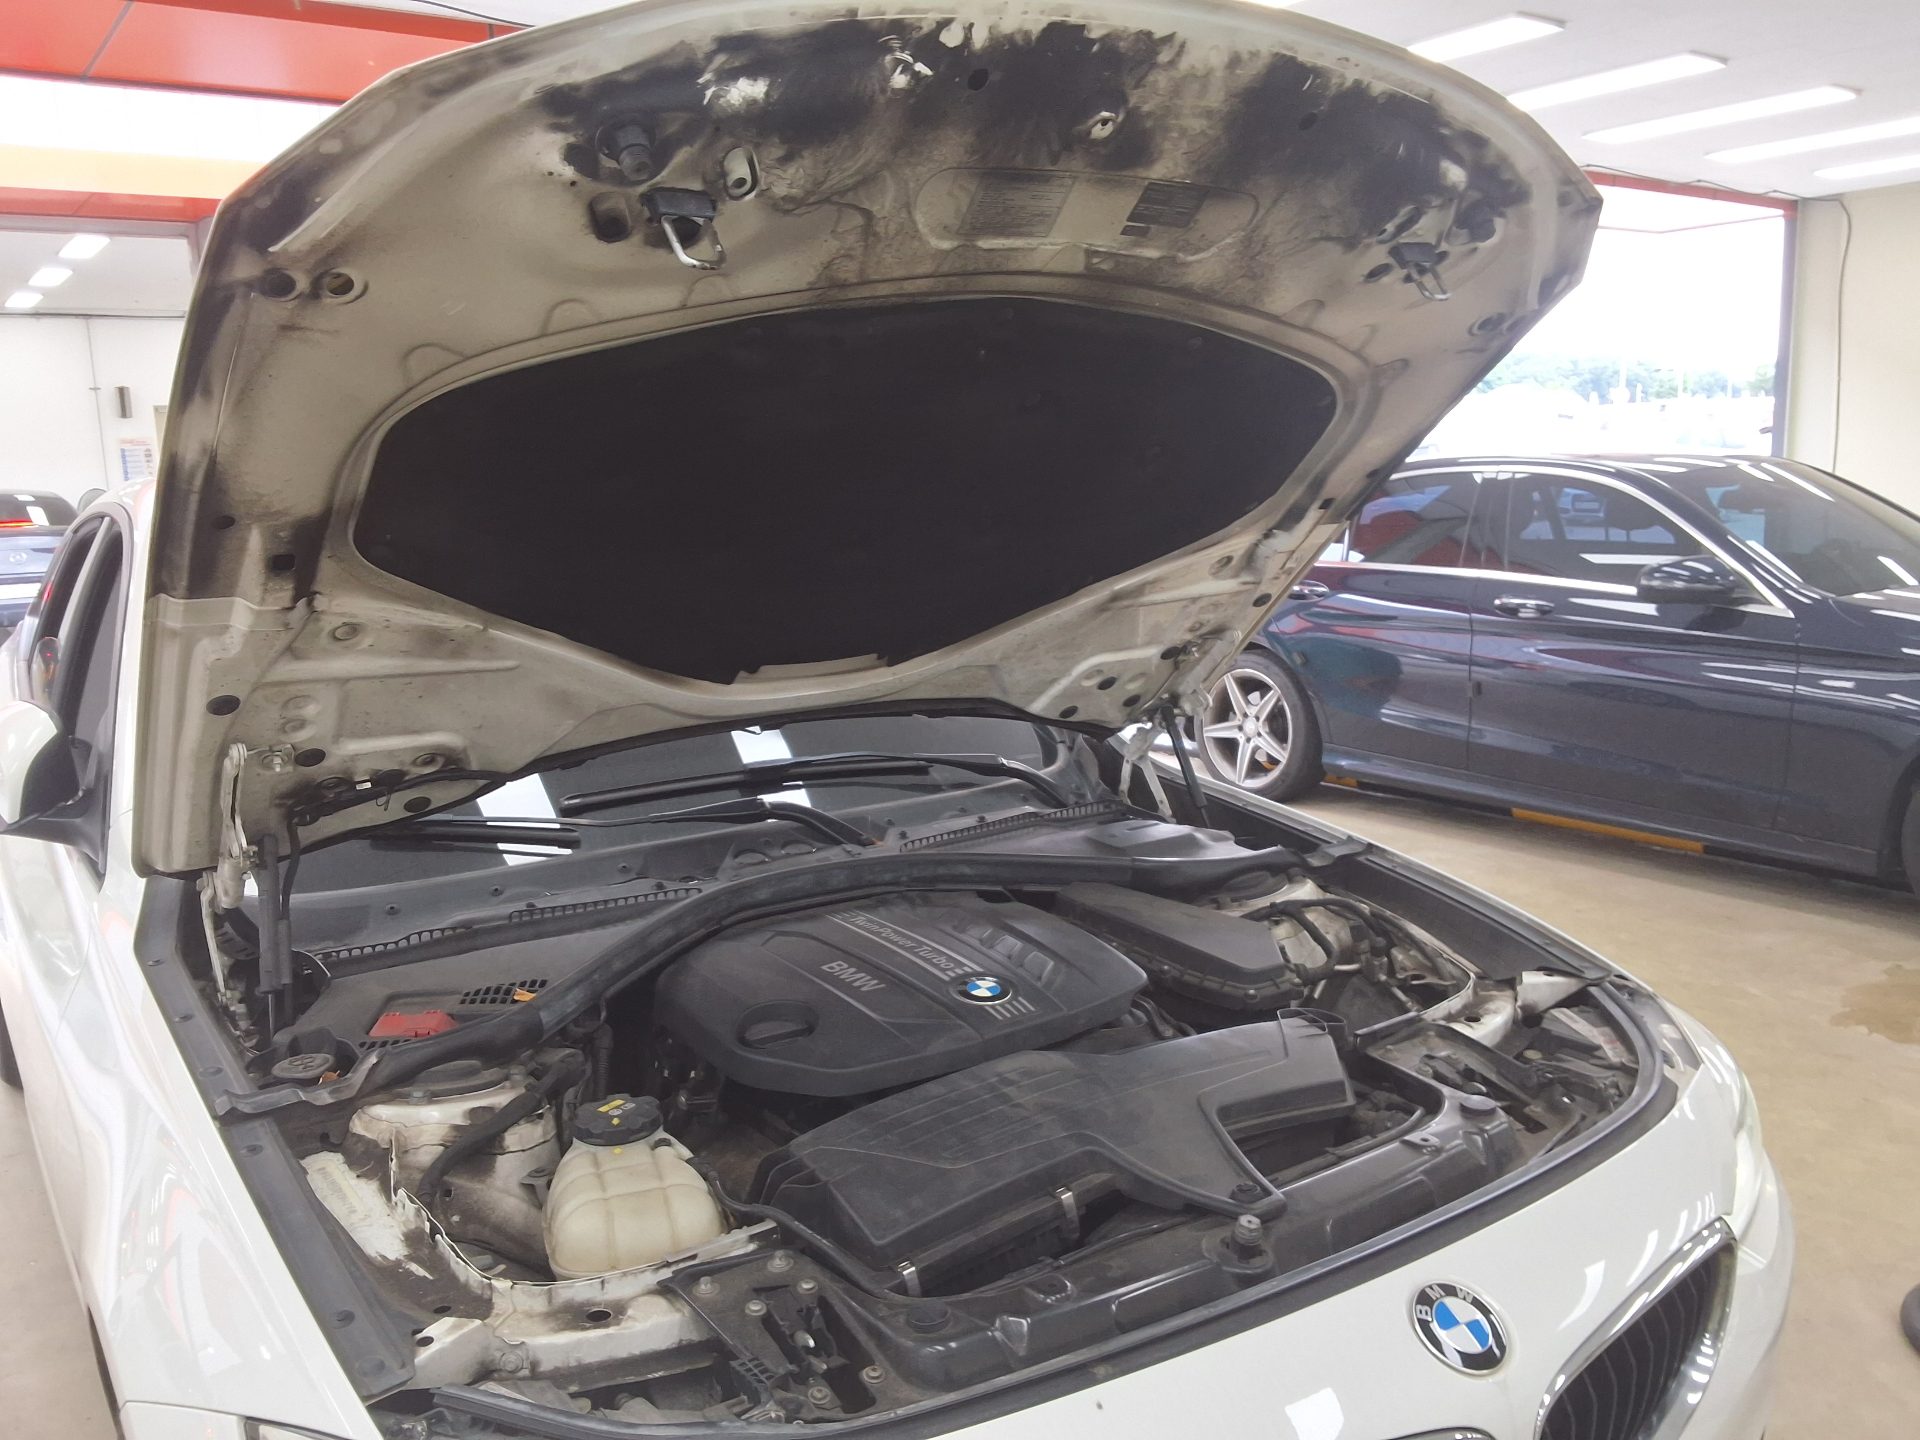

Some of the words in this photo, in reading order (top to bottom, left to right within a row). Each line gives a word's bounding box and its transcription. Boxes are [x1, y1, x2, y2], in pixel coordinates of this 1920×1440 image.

[849, 916, 918, 947] TwinPower
[913, 945, 954, 969] Turbo
[819, 960, 886, 991] BMW
[1415, 1283, 1474, 1322] BMW
